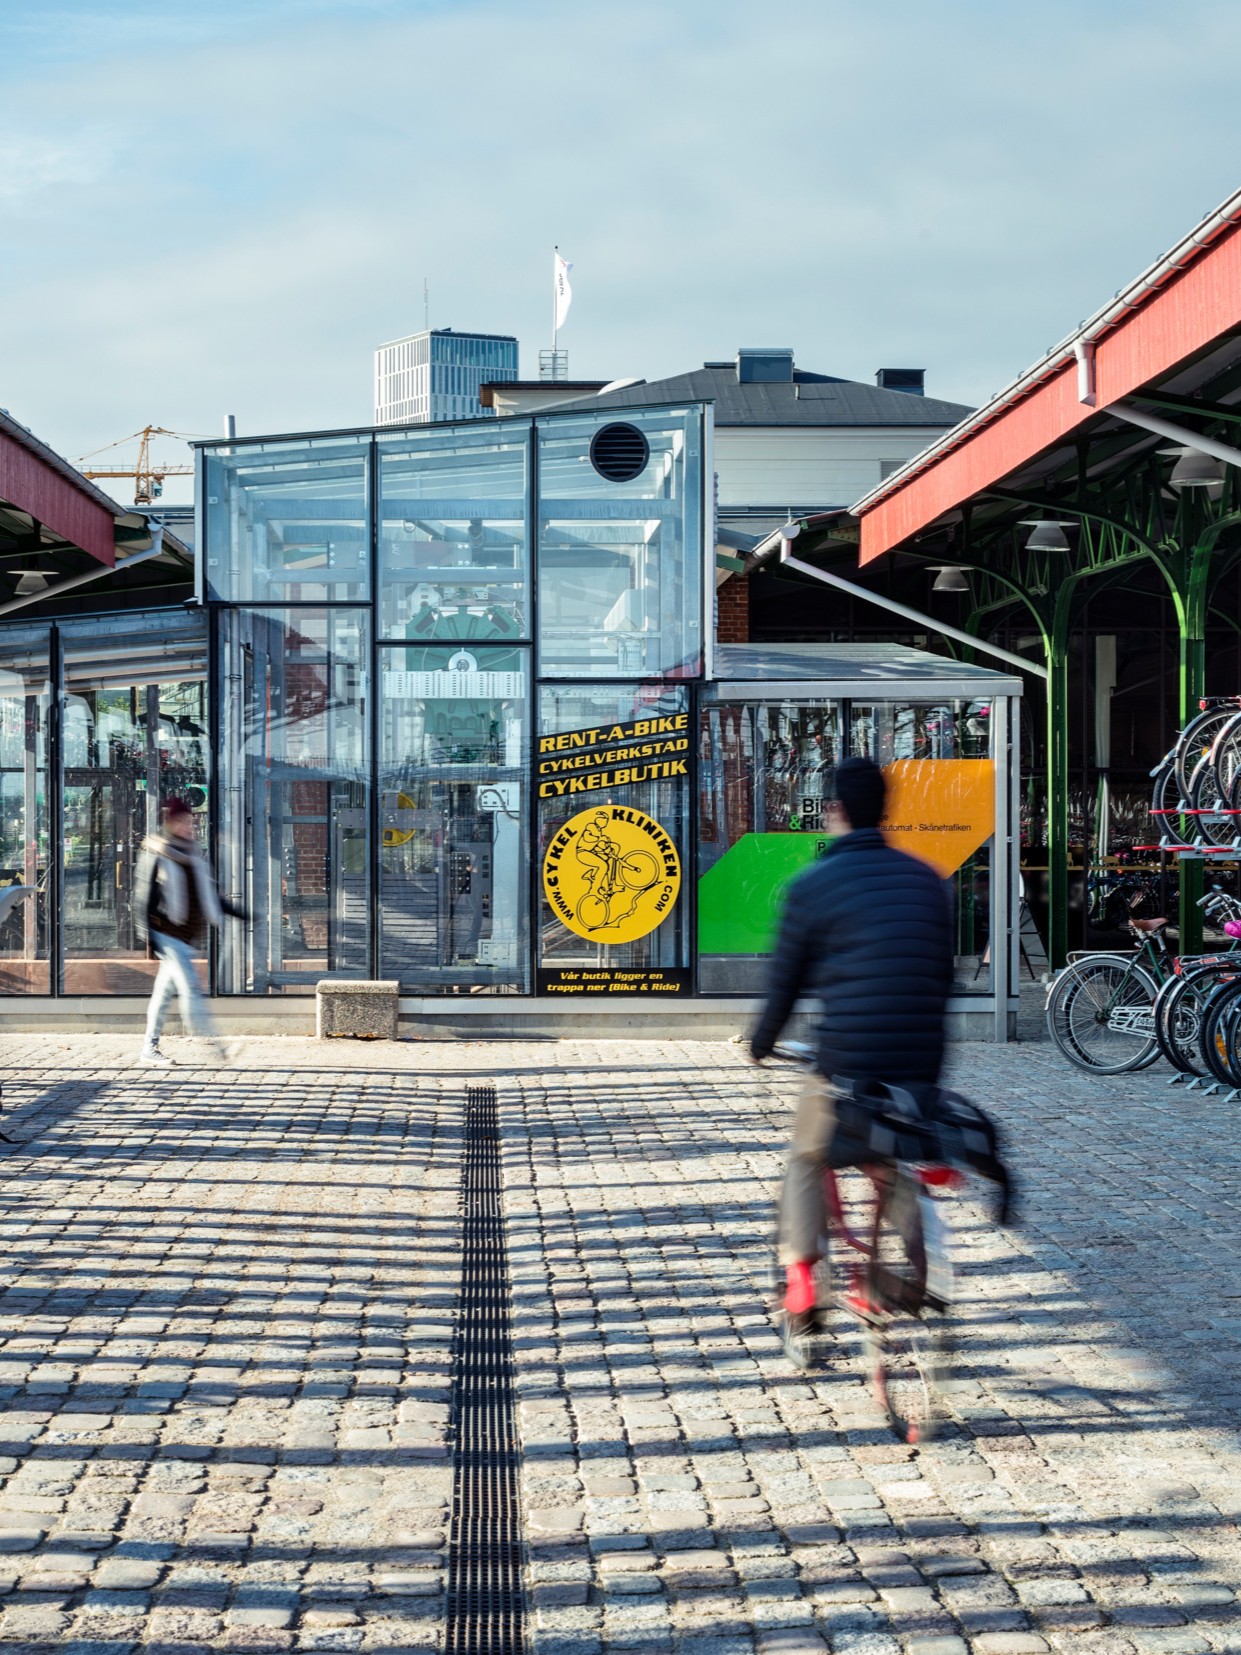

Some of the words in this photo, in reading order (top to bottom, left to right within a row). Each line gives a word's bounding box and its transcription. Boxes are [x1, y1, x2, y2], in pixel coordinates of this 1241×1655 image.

[539, 714, 688, 753] RENT-A-BIKE
[539, 738, 688, 774] CYKELVERKSTAD
[539, 759, 688, 798] CYKELBUTIK
[919, 823, 972, 831] Skånetrafiken
[546, 984, 584, 992] trappa
[608, 983, 637, 992] (Bike
[639, 983, 648, 991] &
[651, 983, 680, 992] Ride)
[560, 971, 580, 980] Vår
[582, 972, 611, 980] butik
[614, 972, 647, 981] ligger
